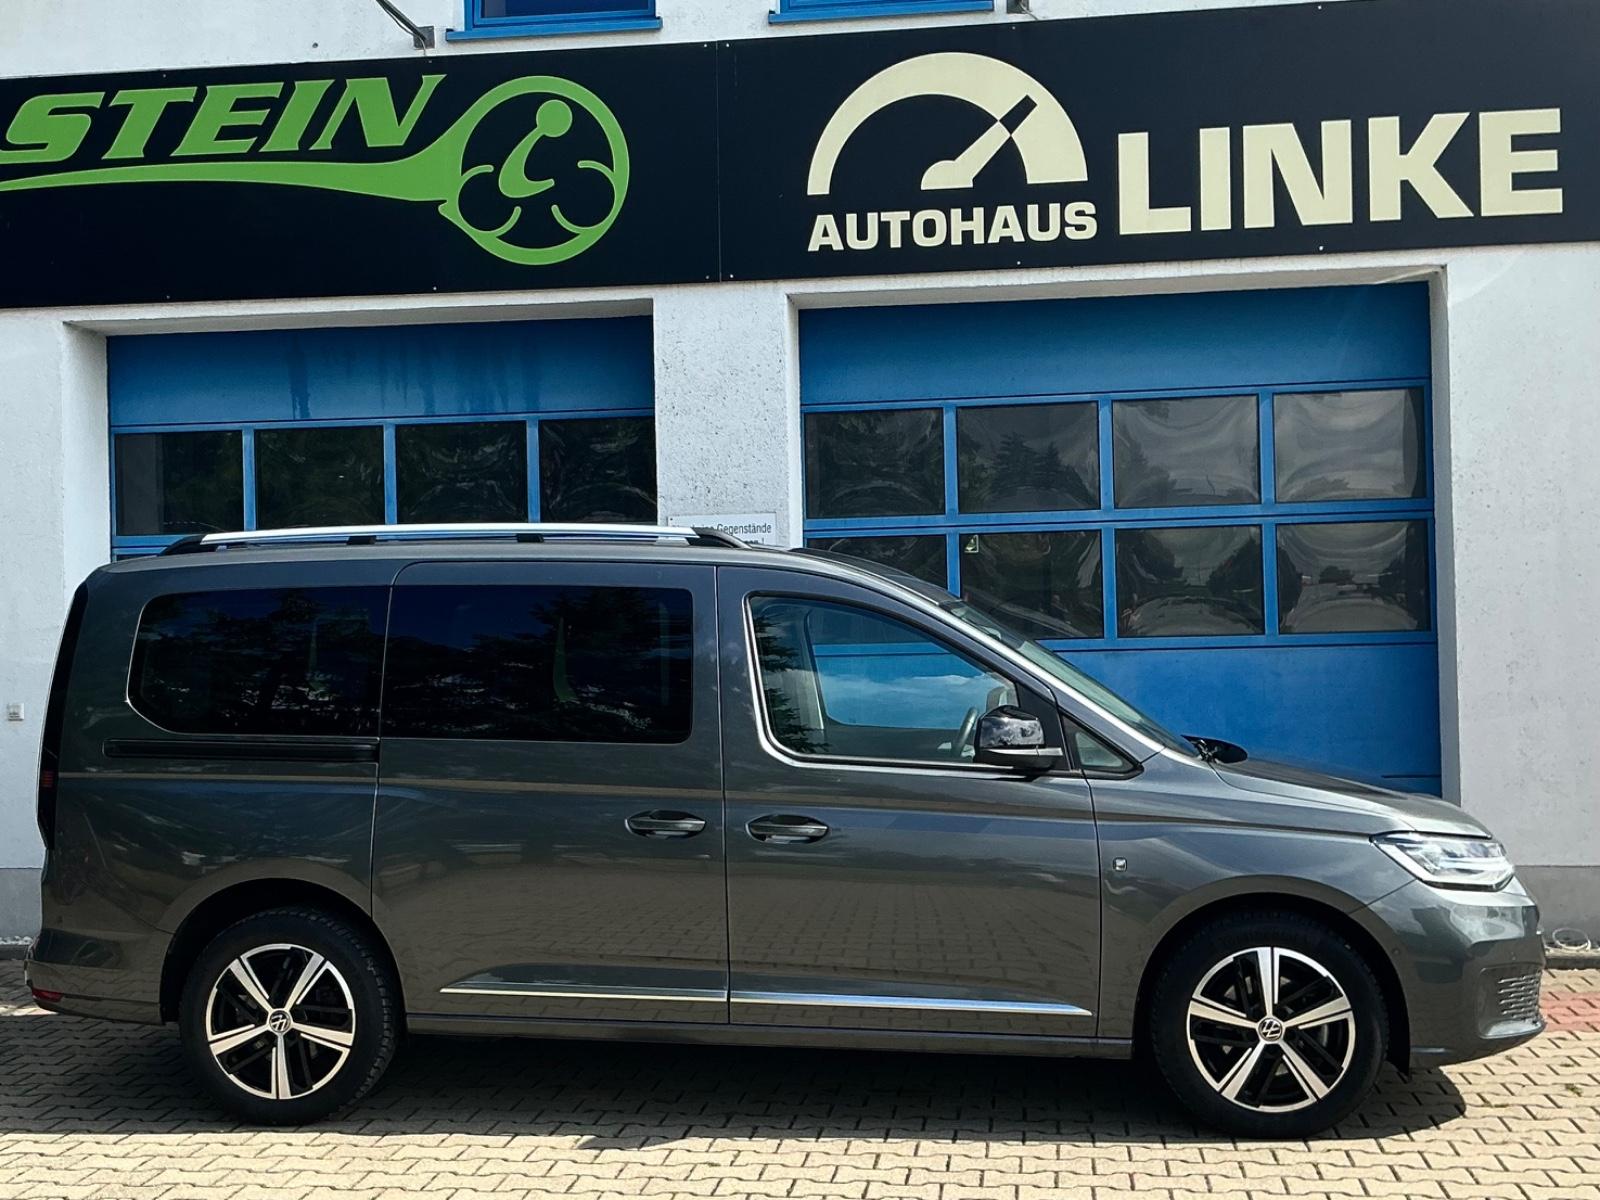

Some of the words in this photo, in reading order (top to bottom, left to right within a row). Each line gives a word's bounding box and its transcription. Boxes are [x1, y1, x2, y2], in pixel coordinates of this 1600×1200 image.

[0, 74, 447, 164] STEIN
[807, 201, 1098, 252] AUTOHAUS
[1118, 108, 1563, 235] LINKE
